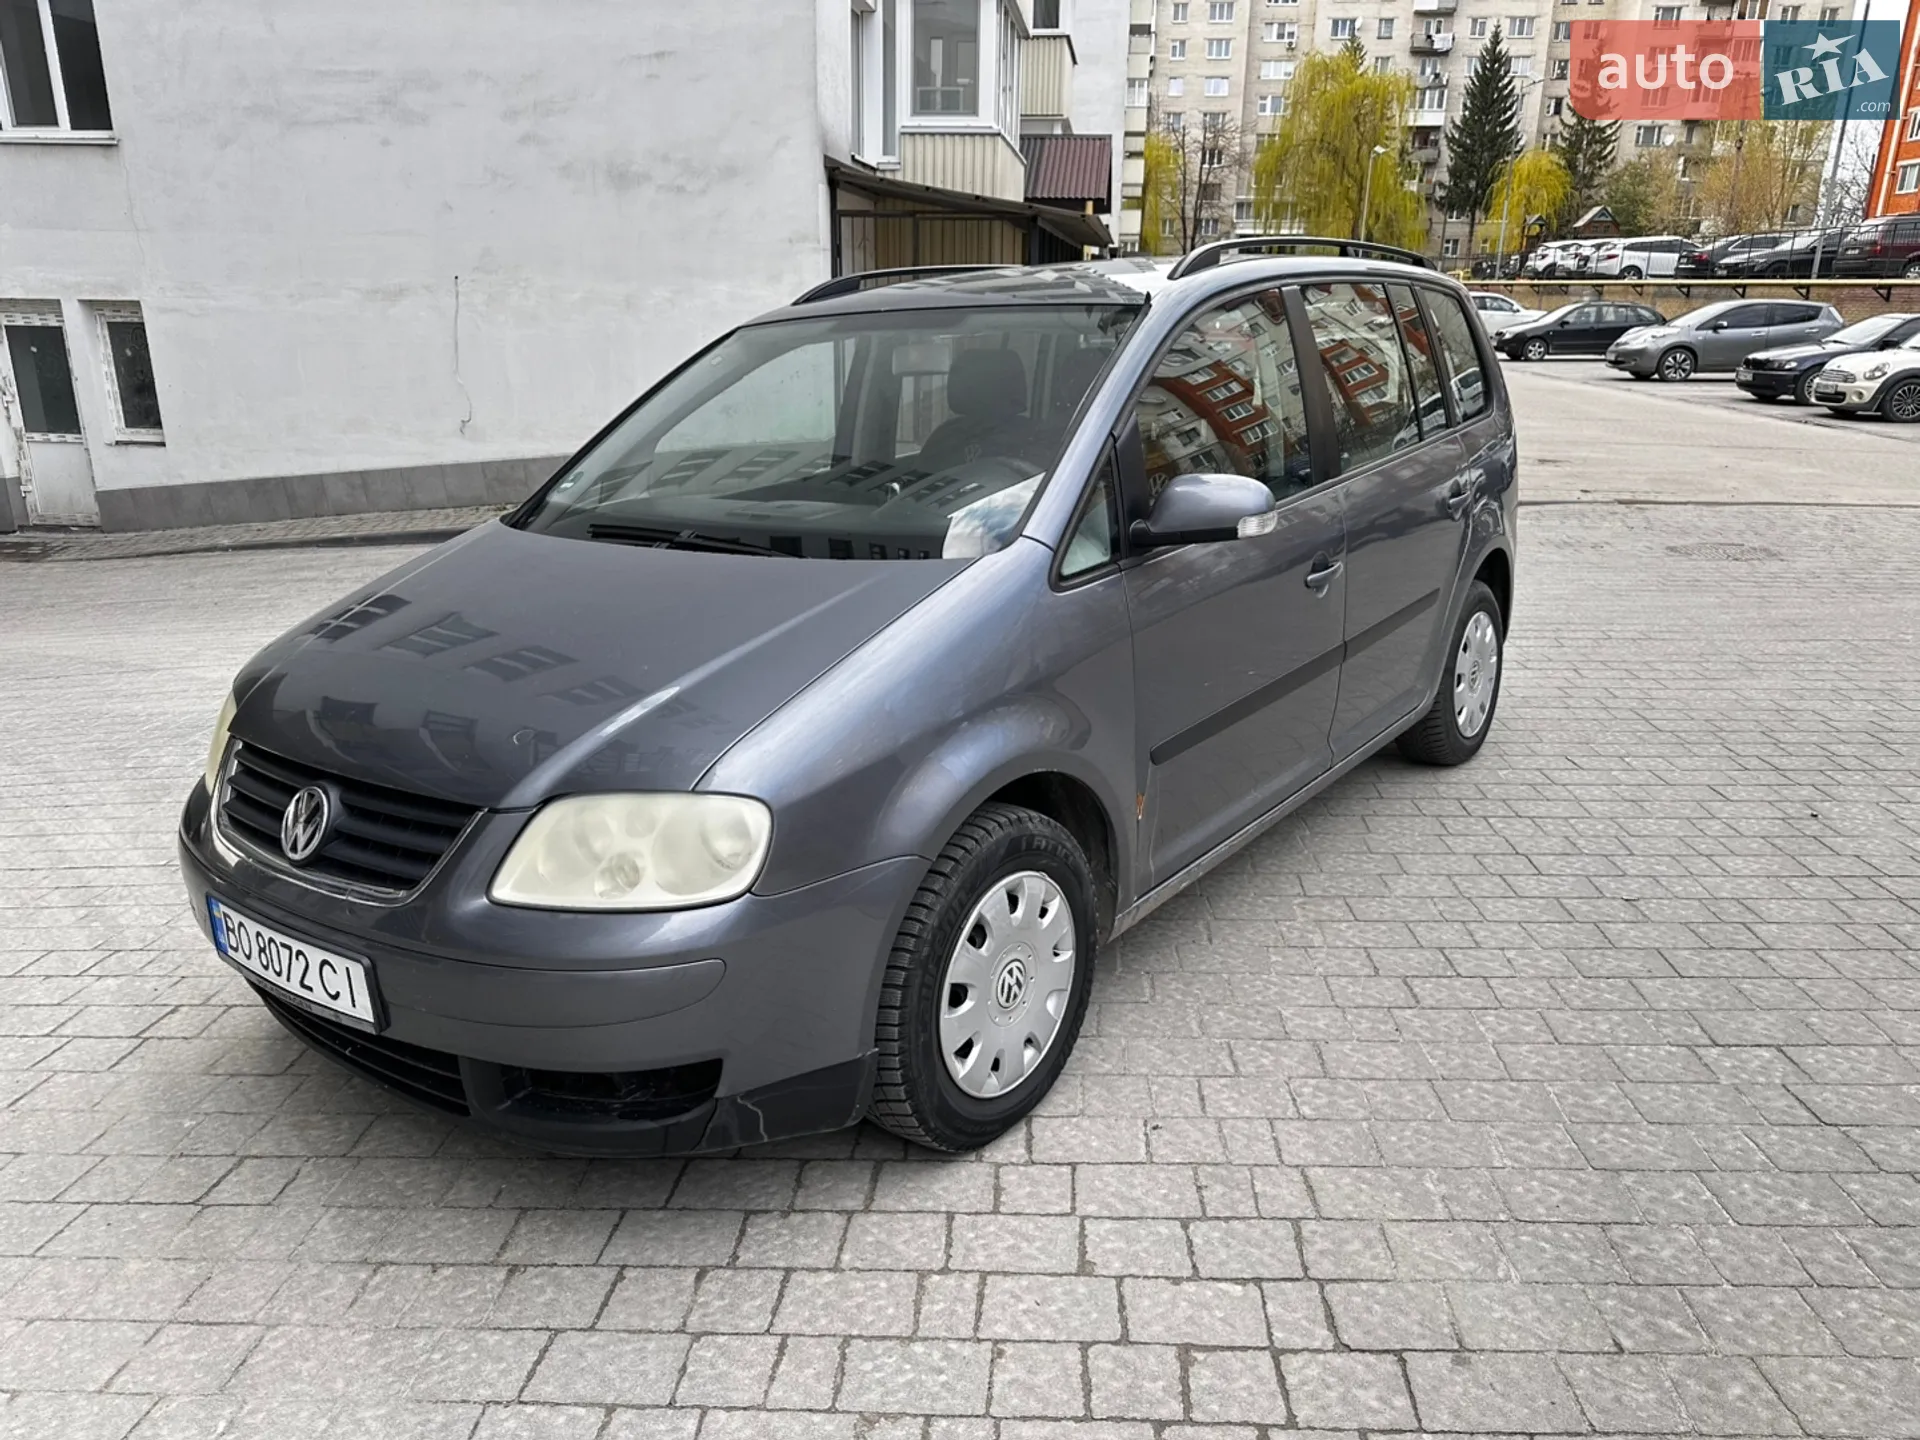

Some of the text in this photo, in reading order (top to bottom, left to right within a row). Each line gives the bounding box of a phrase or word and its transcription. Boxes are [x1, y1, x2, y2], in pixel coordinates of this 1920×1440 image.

[222, 910, 252, 961] BO
[255, 930, 314, 993] 8072
[319, 958, 357, 1009] CI
